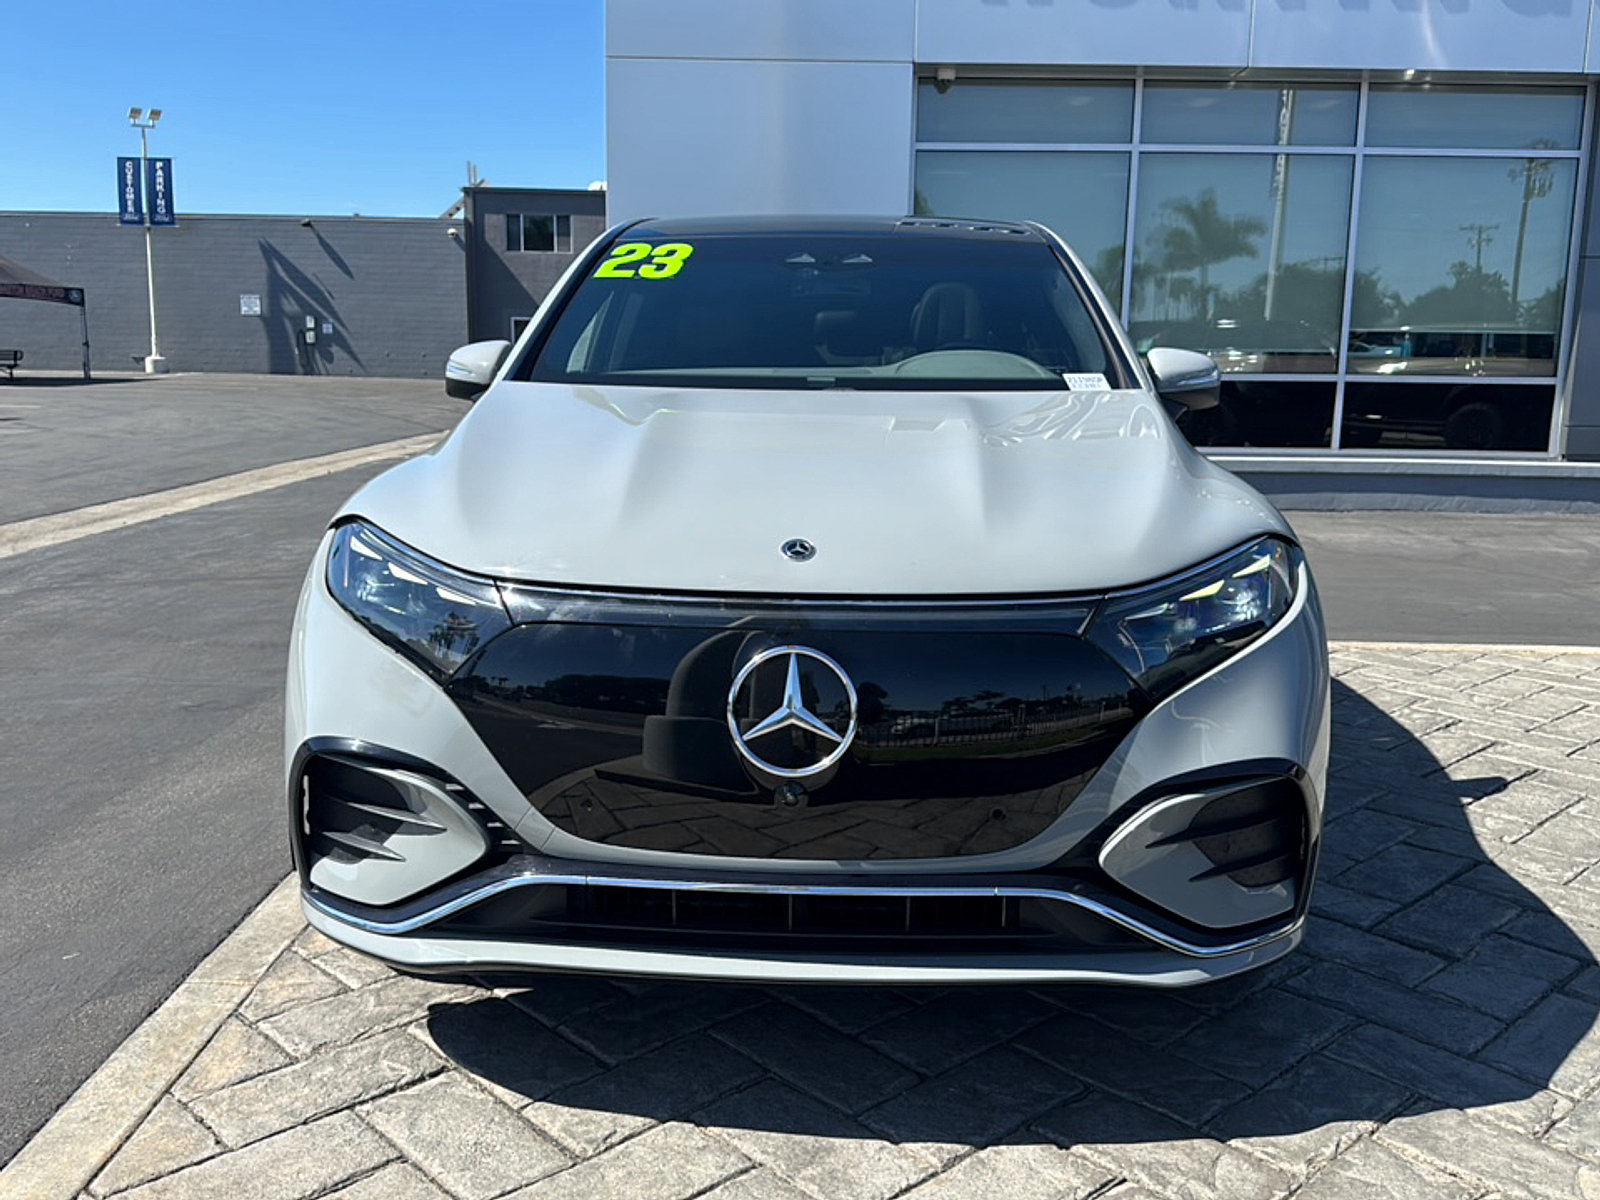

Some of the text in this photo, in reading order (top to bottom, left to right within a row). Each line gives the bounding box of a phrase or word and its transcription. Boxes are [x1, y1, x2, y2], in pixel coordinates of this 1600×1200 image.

[125, 161, 135, 214] CUSTOMER
[156, 161, 166, 214] PARKING
[593, 243, 694, 279] 23
